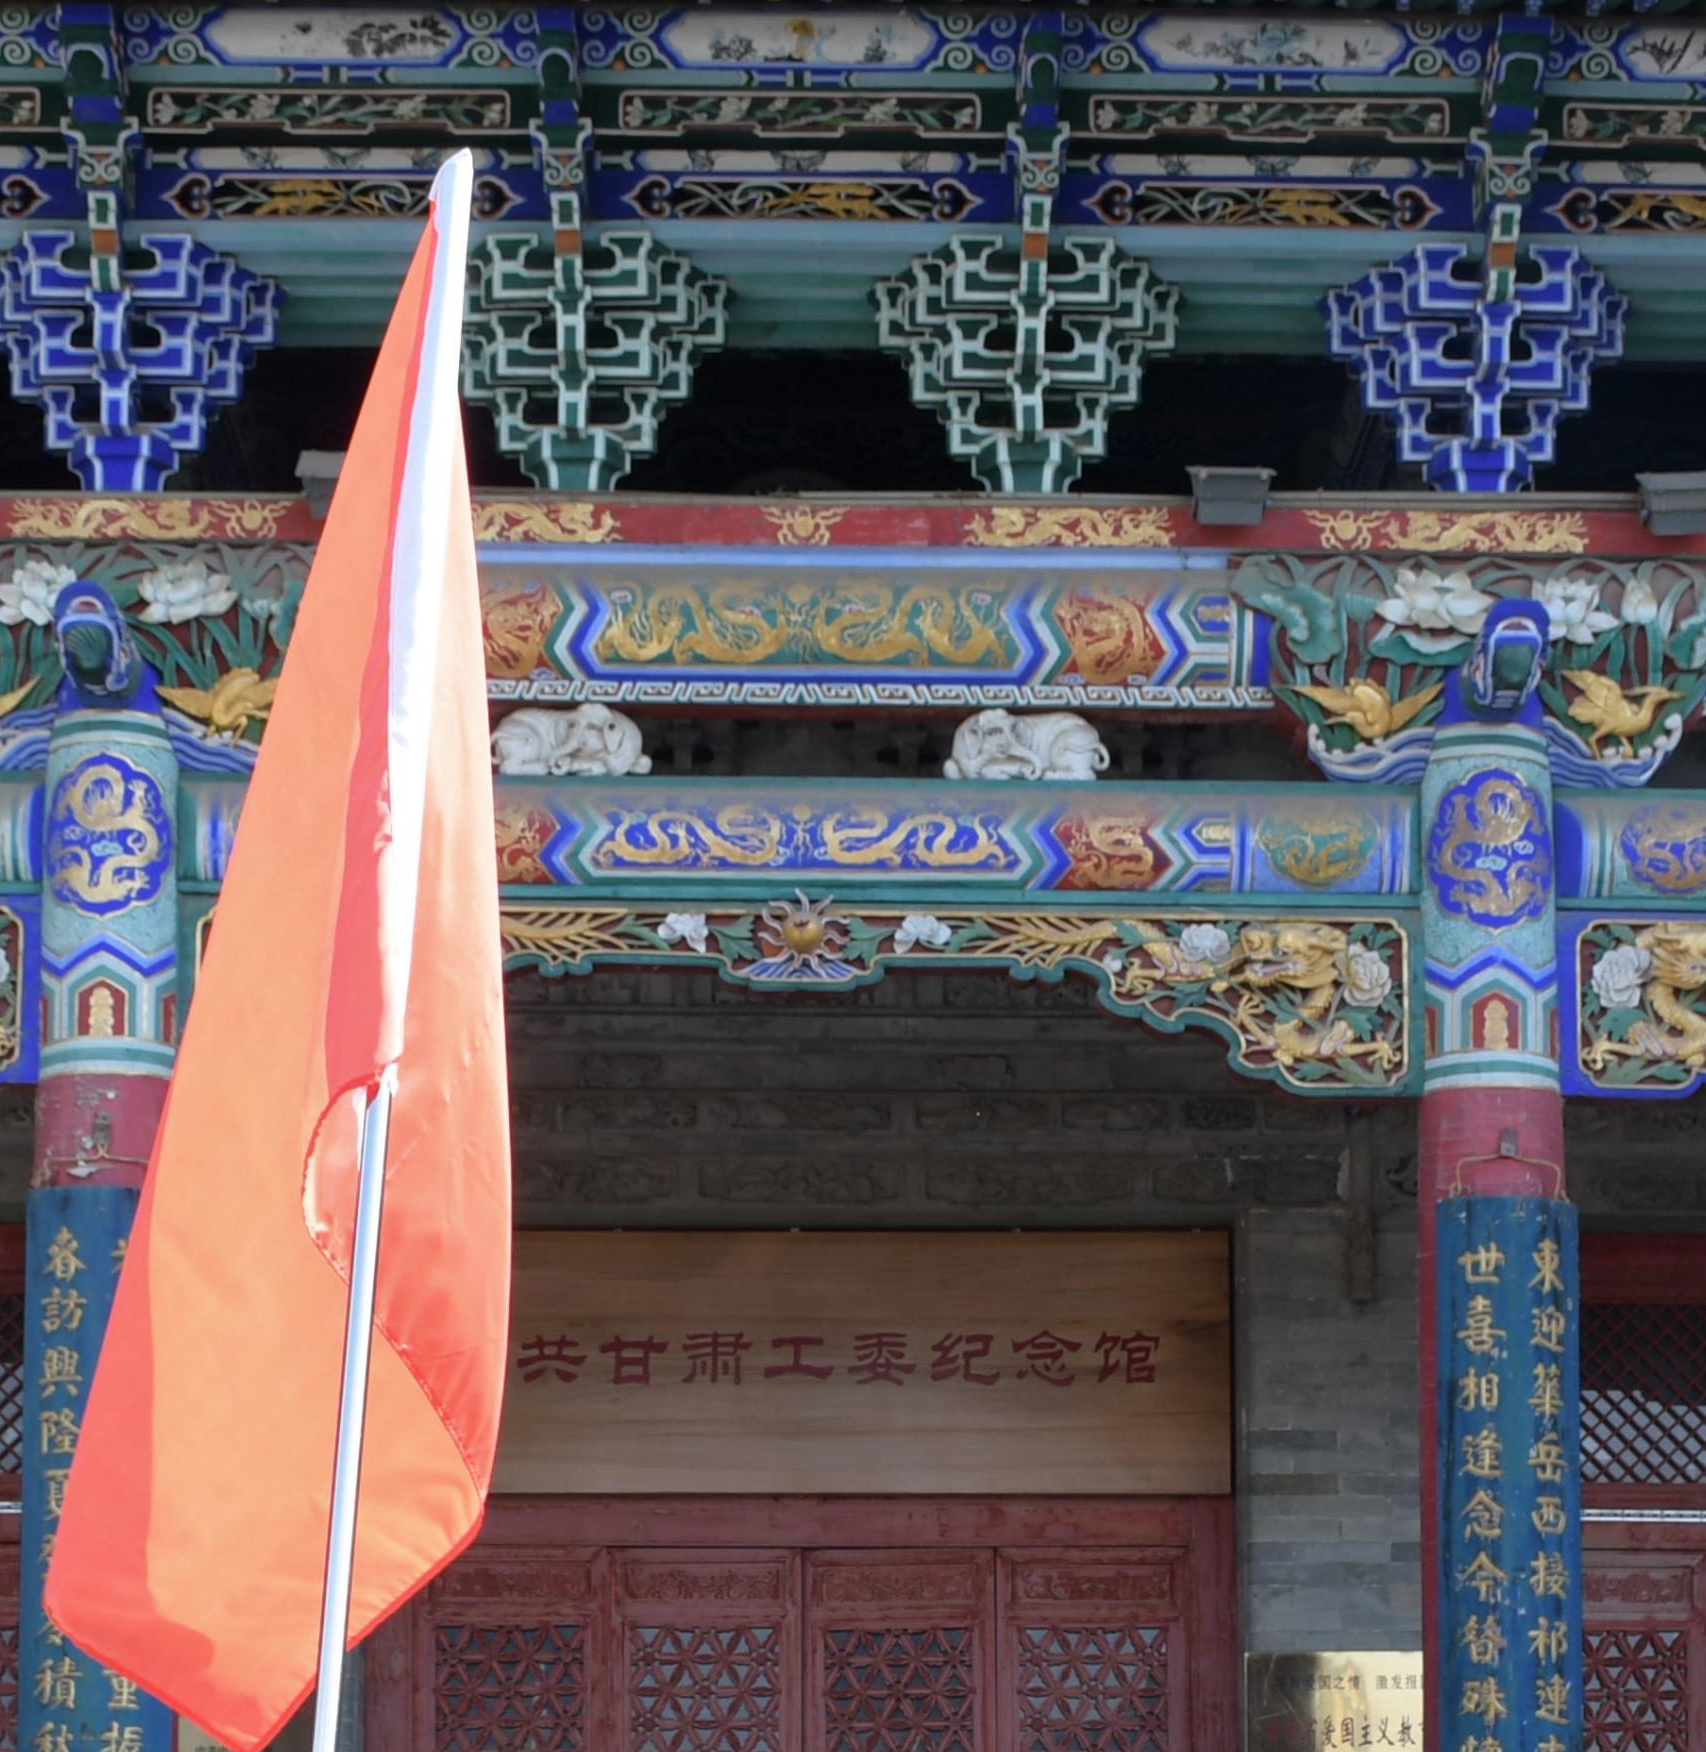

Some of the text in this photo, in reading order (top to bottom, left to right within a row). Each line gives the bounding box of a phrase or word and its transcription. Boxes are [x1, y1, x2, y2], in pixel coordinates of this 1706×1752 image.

[516, 1328, 1162, 1388] 共甘肃工委纪念馆
